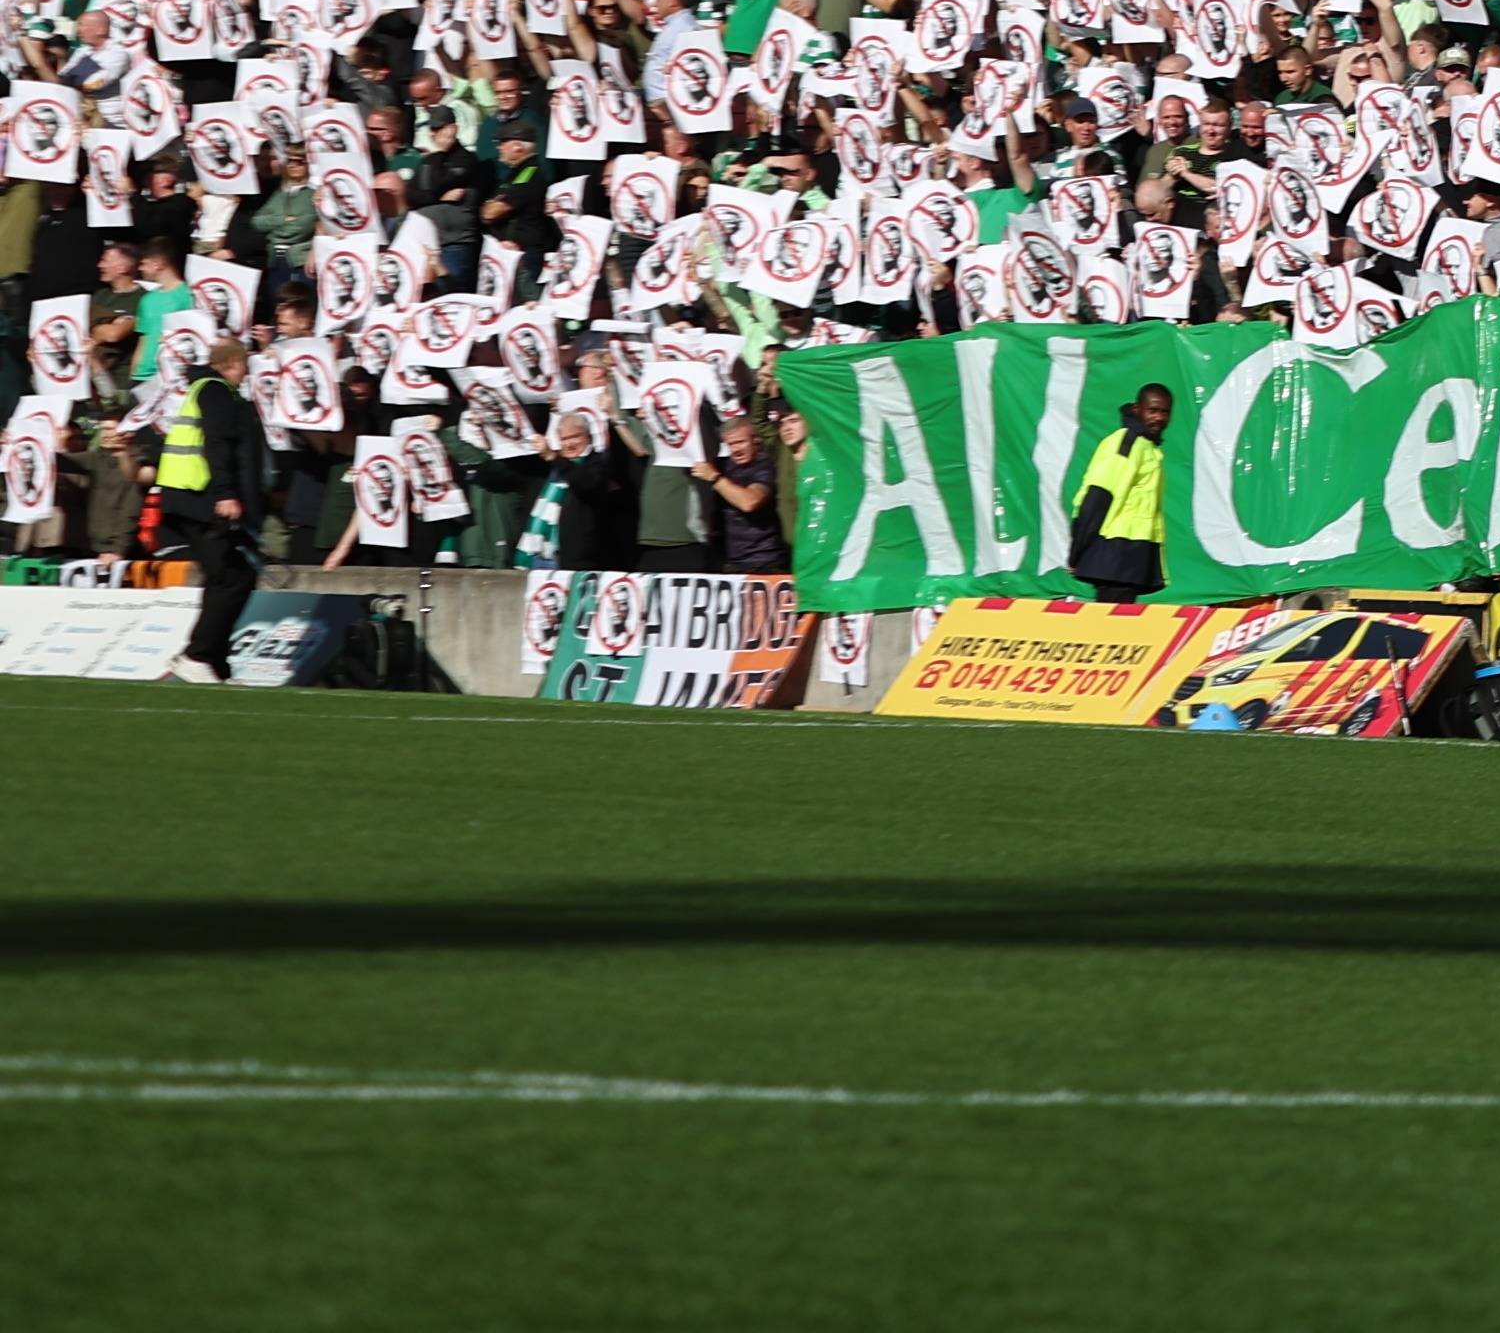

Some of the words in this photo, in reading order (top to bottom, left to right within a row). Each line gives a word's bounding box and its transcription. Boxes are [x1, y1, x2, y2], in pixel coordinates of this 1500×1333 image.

[934, 636, 987, 657] HIRE
[984, 638, 1026, 660] THE
[1022, 640, 1104, 664] THISTLE
[1100, 644, 1153, 665] TAXI
[950, 662, 1013, 691] 0141
[1008, 666, 1064, 694] 429
[1060, 669, 1131, 696] 7070
